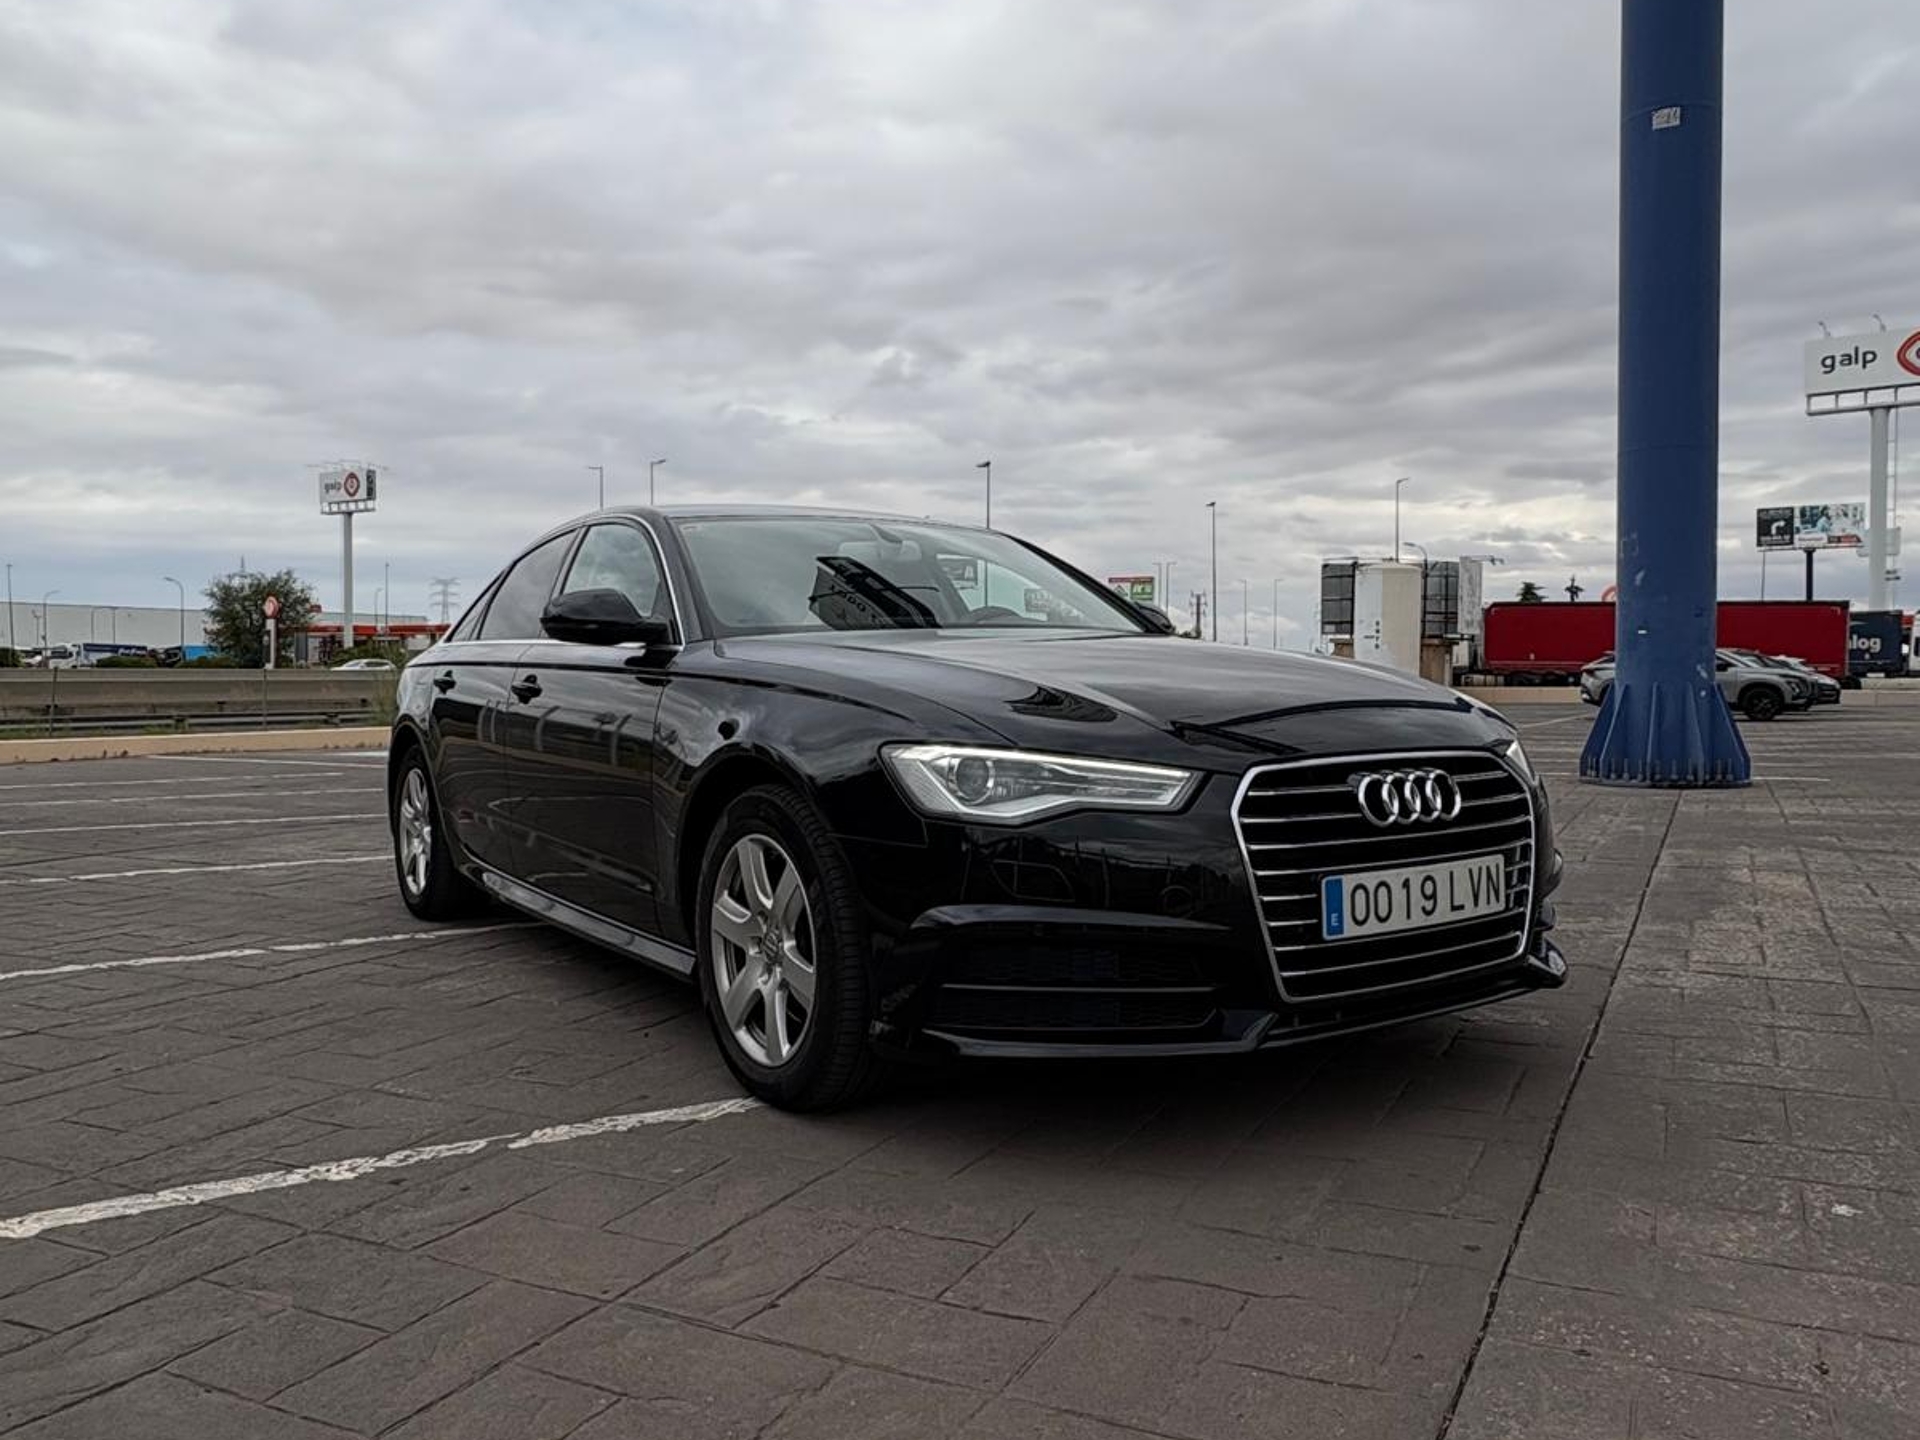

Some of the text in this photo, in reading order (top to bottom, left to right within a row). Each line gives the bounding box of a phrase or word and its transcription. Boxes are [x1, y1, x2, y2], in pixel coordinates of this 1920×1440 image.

[1820, 345, 1878, 375] galp
[1330, 863, 1501, 927] E 0019 LVN
